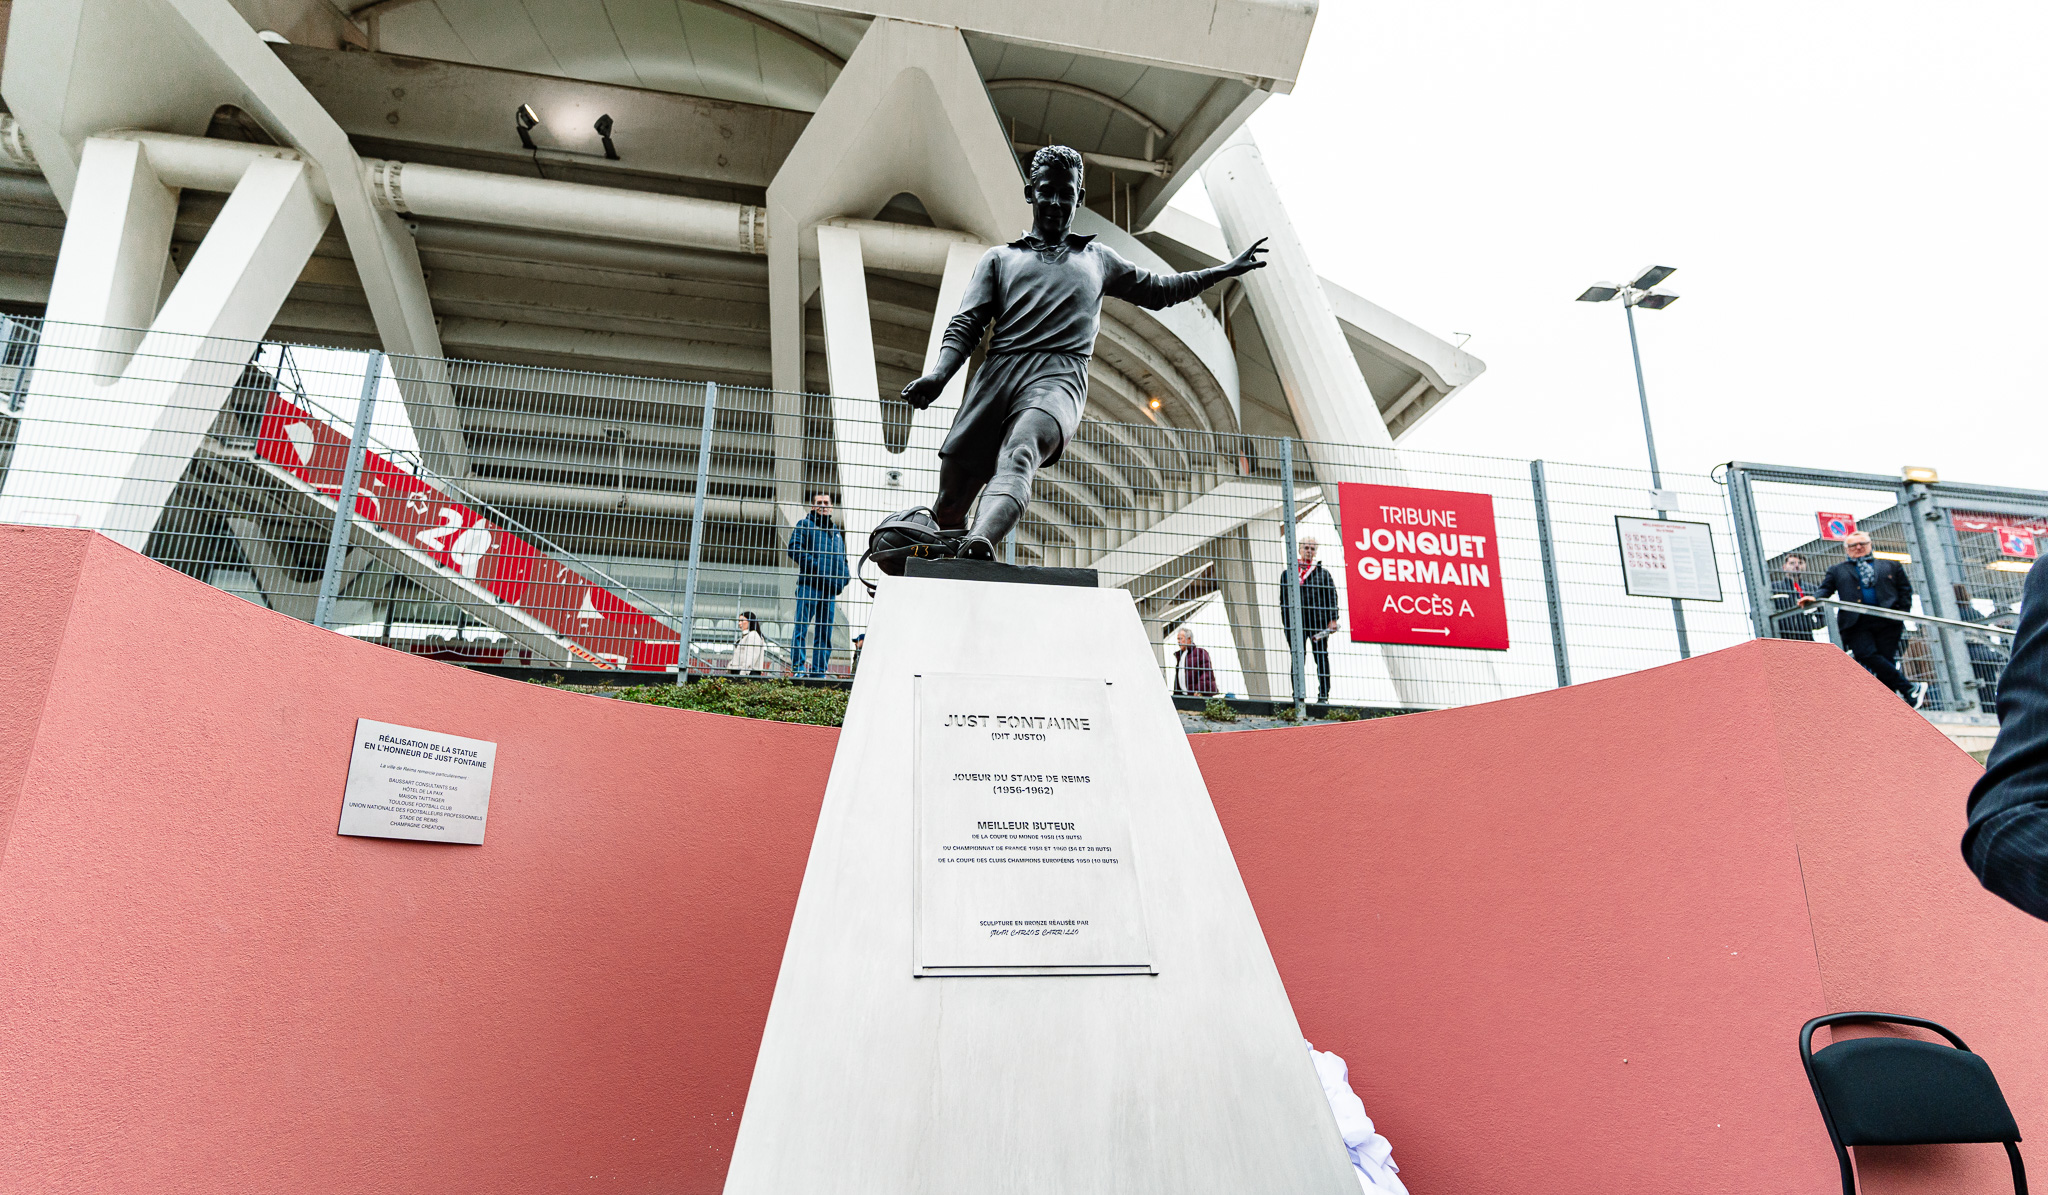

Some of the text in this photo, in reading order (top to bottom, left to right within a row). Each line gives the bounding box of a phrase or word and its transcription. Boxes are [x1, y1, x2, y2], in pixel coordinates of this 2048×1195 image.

[1380, 506, 1458, 528] TRIBUNE
[1355, 528, 1486, 558] JONQUET
[1358, 556, 1490, 588] GERMAIN
[1382, 594, 1475, 618] ACCÈS A
[944, 714, 1090, 730] JUST FONTAINE
[379, 734, 478, 758] RÉALISATION DE LA STATUE
[992, 732, 1046, 742] (DIT JUSTO)
[364, 742, 486, 768] EN L'HONNEUR DE JUST FONTAINE
[952, 774, 1090, 784] JOUEUR DU STADE DE REIMS
[993, 786, 1054, 795] (1956-1962)
[389, 799, 414, 807] TOULOUSE
[977, 822, 1075, 830] MEILLEUR BUTEUR
